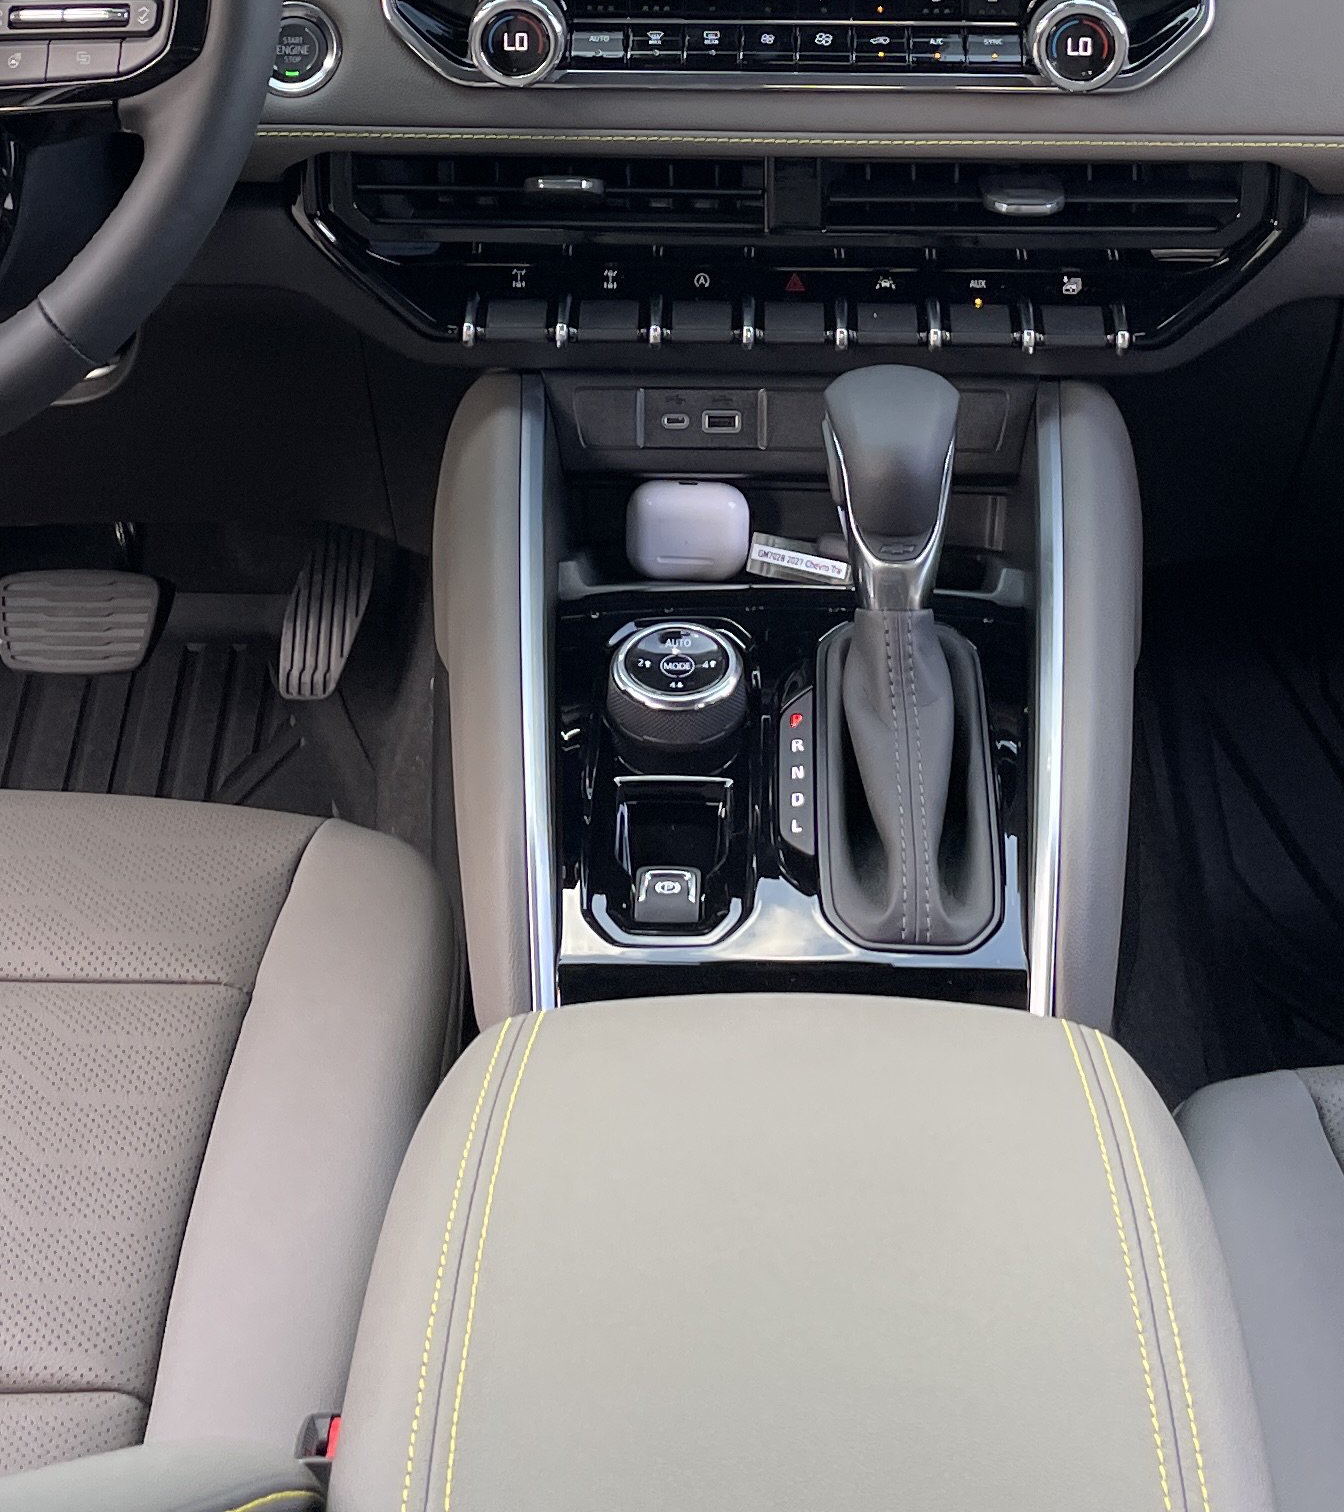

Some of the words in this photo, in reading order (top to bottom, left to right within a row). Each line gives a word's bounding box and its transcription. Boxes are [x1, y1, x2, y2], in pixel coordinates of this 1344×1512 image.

[282, 36, 304, 44] START
[504, 33, 528, 51] LO
[589, 35, 610, 43] AUTO
[276, 45, 310, 55] ENGINE
[1067, 37, 1093, 56] LO
[284, 55, 302, 63] STOP
[969, 279, 987, 289] AUX
[664, 638, 692, 648] AUTO
[663, 661, 691, 670] MODE
[790, 713, 803, 728] P
[791, 739, 805, 753] R
[791, 765, 805, 780] N
[791, 792, 805, 807] D
[791, 819, 803, 833] L
